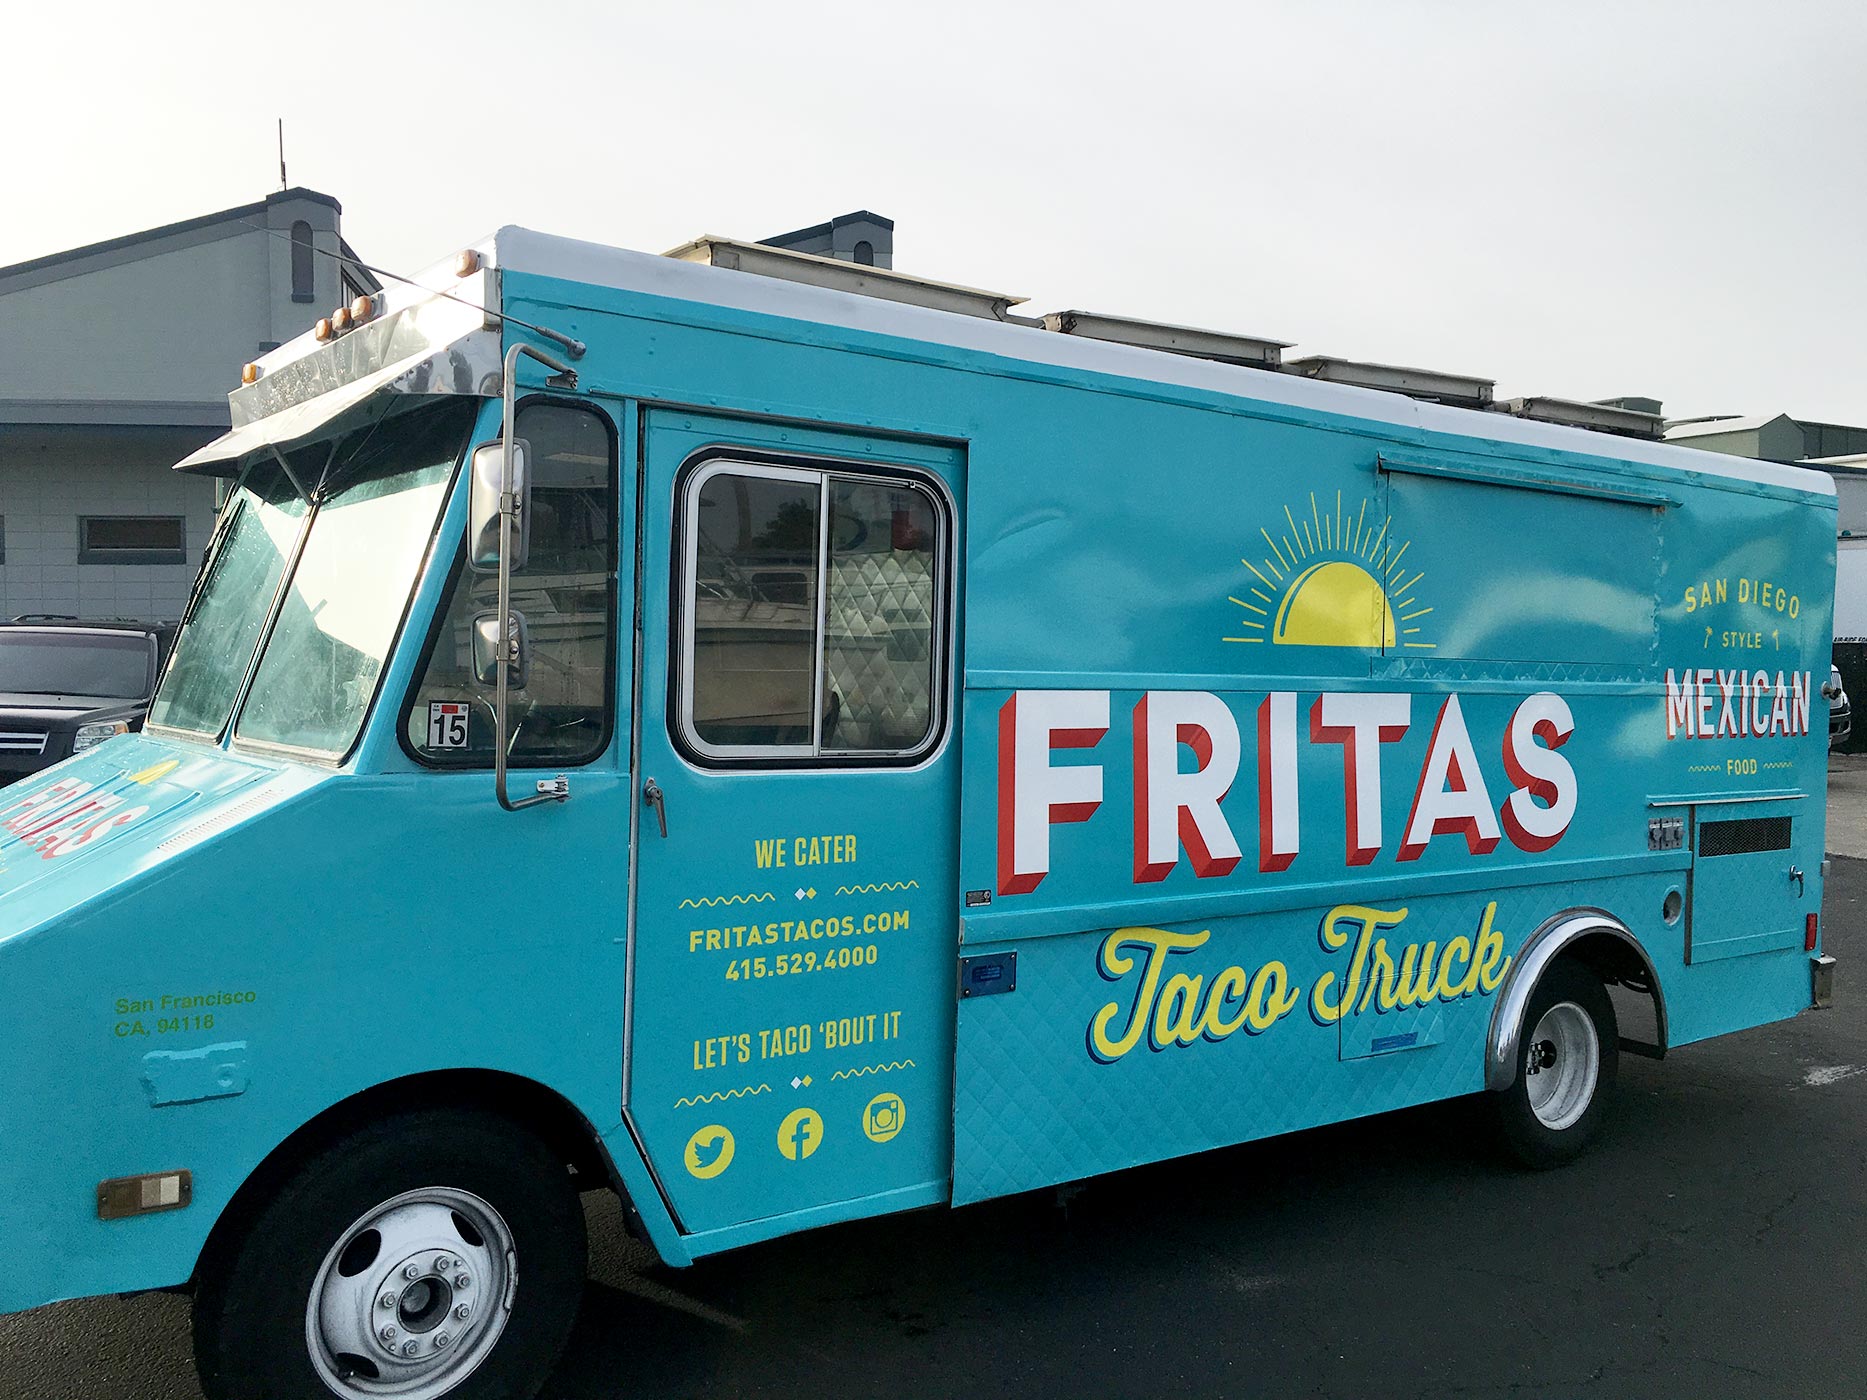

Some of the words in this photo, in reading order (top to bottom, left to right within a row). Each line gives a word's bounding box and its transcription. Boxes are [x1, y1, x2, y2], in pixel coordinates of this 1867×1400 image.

[1684, 578, 1728, 613] SAN
[1738, 578, 1800, 619] DIEGO
[1722, 631, 1762, 649] STYLE
[1665, 668, 1811, 740] MEXICAN
[434, 715, 466, 745] 15
[1726, 758, 1758, 776] FOOD
[998, 690, 1578, 896] FRITAS
[755, 838, 787, 869] WE
[794, 834, 857, 866] CATER
[689, 910, 910, 953] FRITASTACOS.COM
[725, 944, 878, 981] 415.529.4000
[1085, 927, 1300, 1063] Taco
[1308, 901, 1514, 1027] Truck
[115, 998, 154, 1015] San
[160, 990, 257, 1010] Francisco
[114, 1020, 151, 1038] CA,
[157, 1014, 215, 1035] 94118
[693, 1033, 751, 1071] LET'S
[759, 1024, 812, 1060] TACO
[819, 1014, 877, 1049] 'BOUT
[884, 1010, 902, 1040] IT
